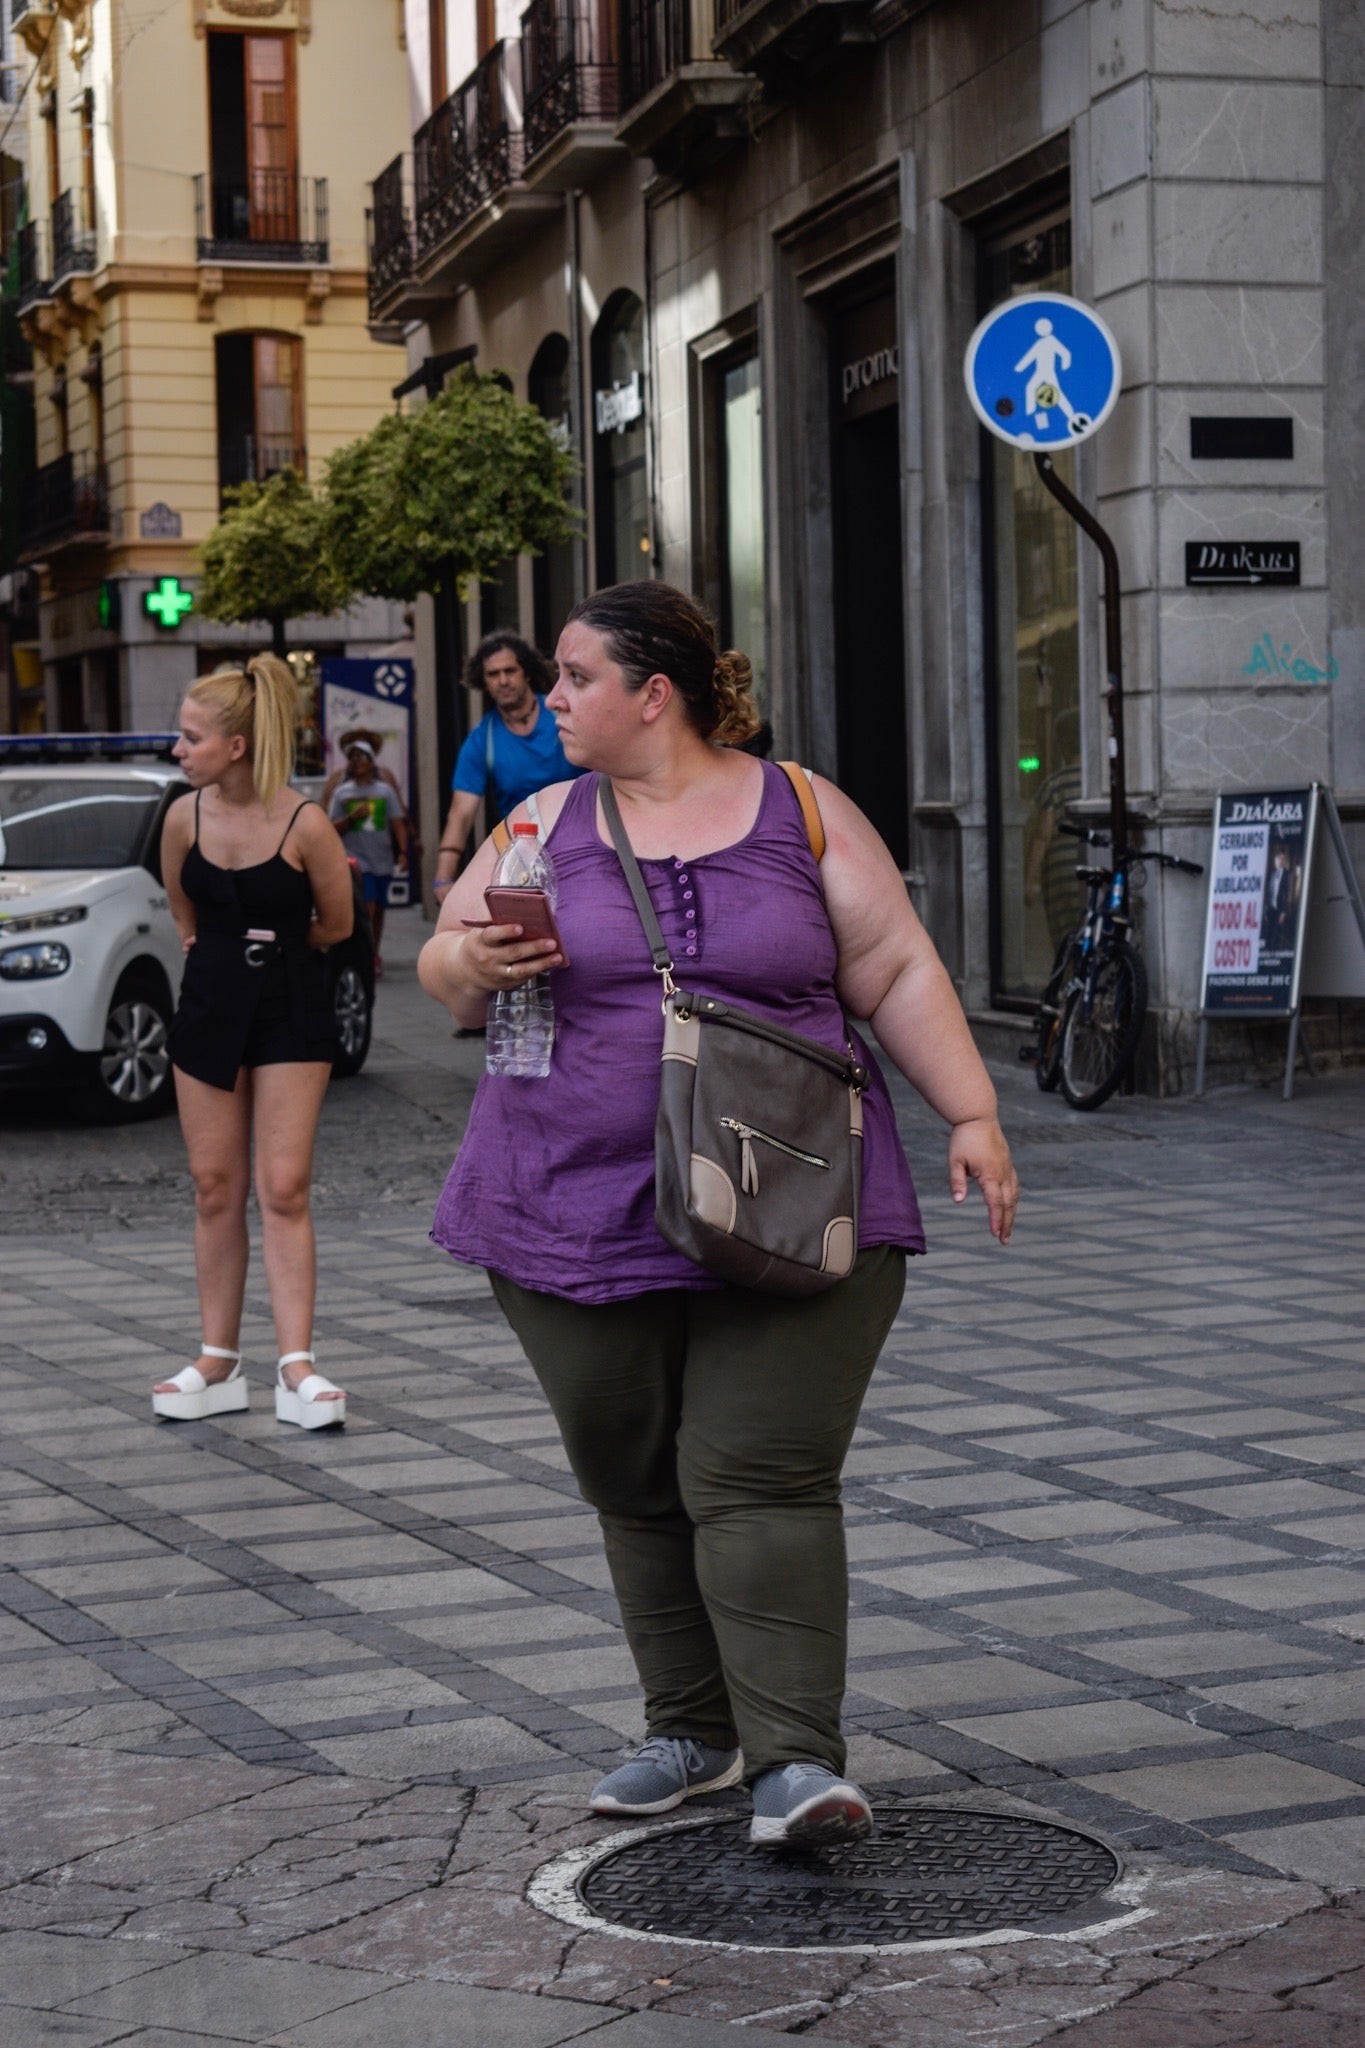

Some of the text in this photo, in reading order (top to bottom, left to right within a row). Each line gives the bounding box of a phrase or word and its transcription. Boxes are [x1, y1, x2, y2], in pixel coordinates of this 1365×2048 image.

[1218, 831, 1265, 851] CERRAMOS
[1230, 853, 1249, 873] POR
[1212, 900, 1259, 930] TODO AL
[1214, 938, 1252, 969] COSTO
